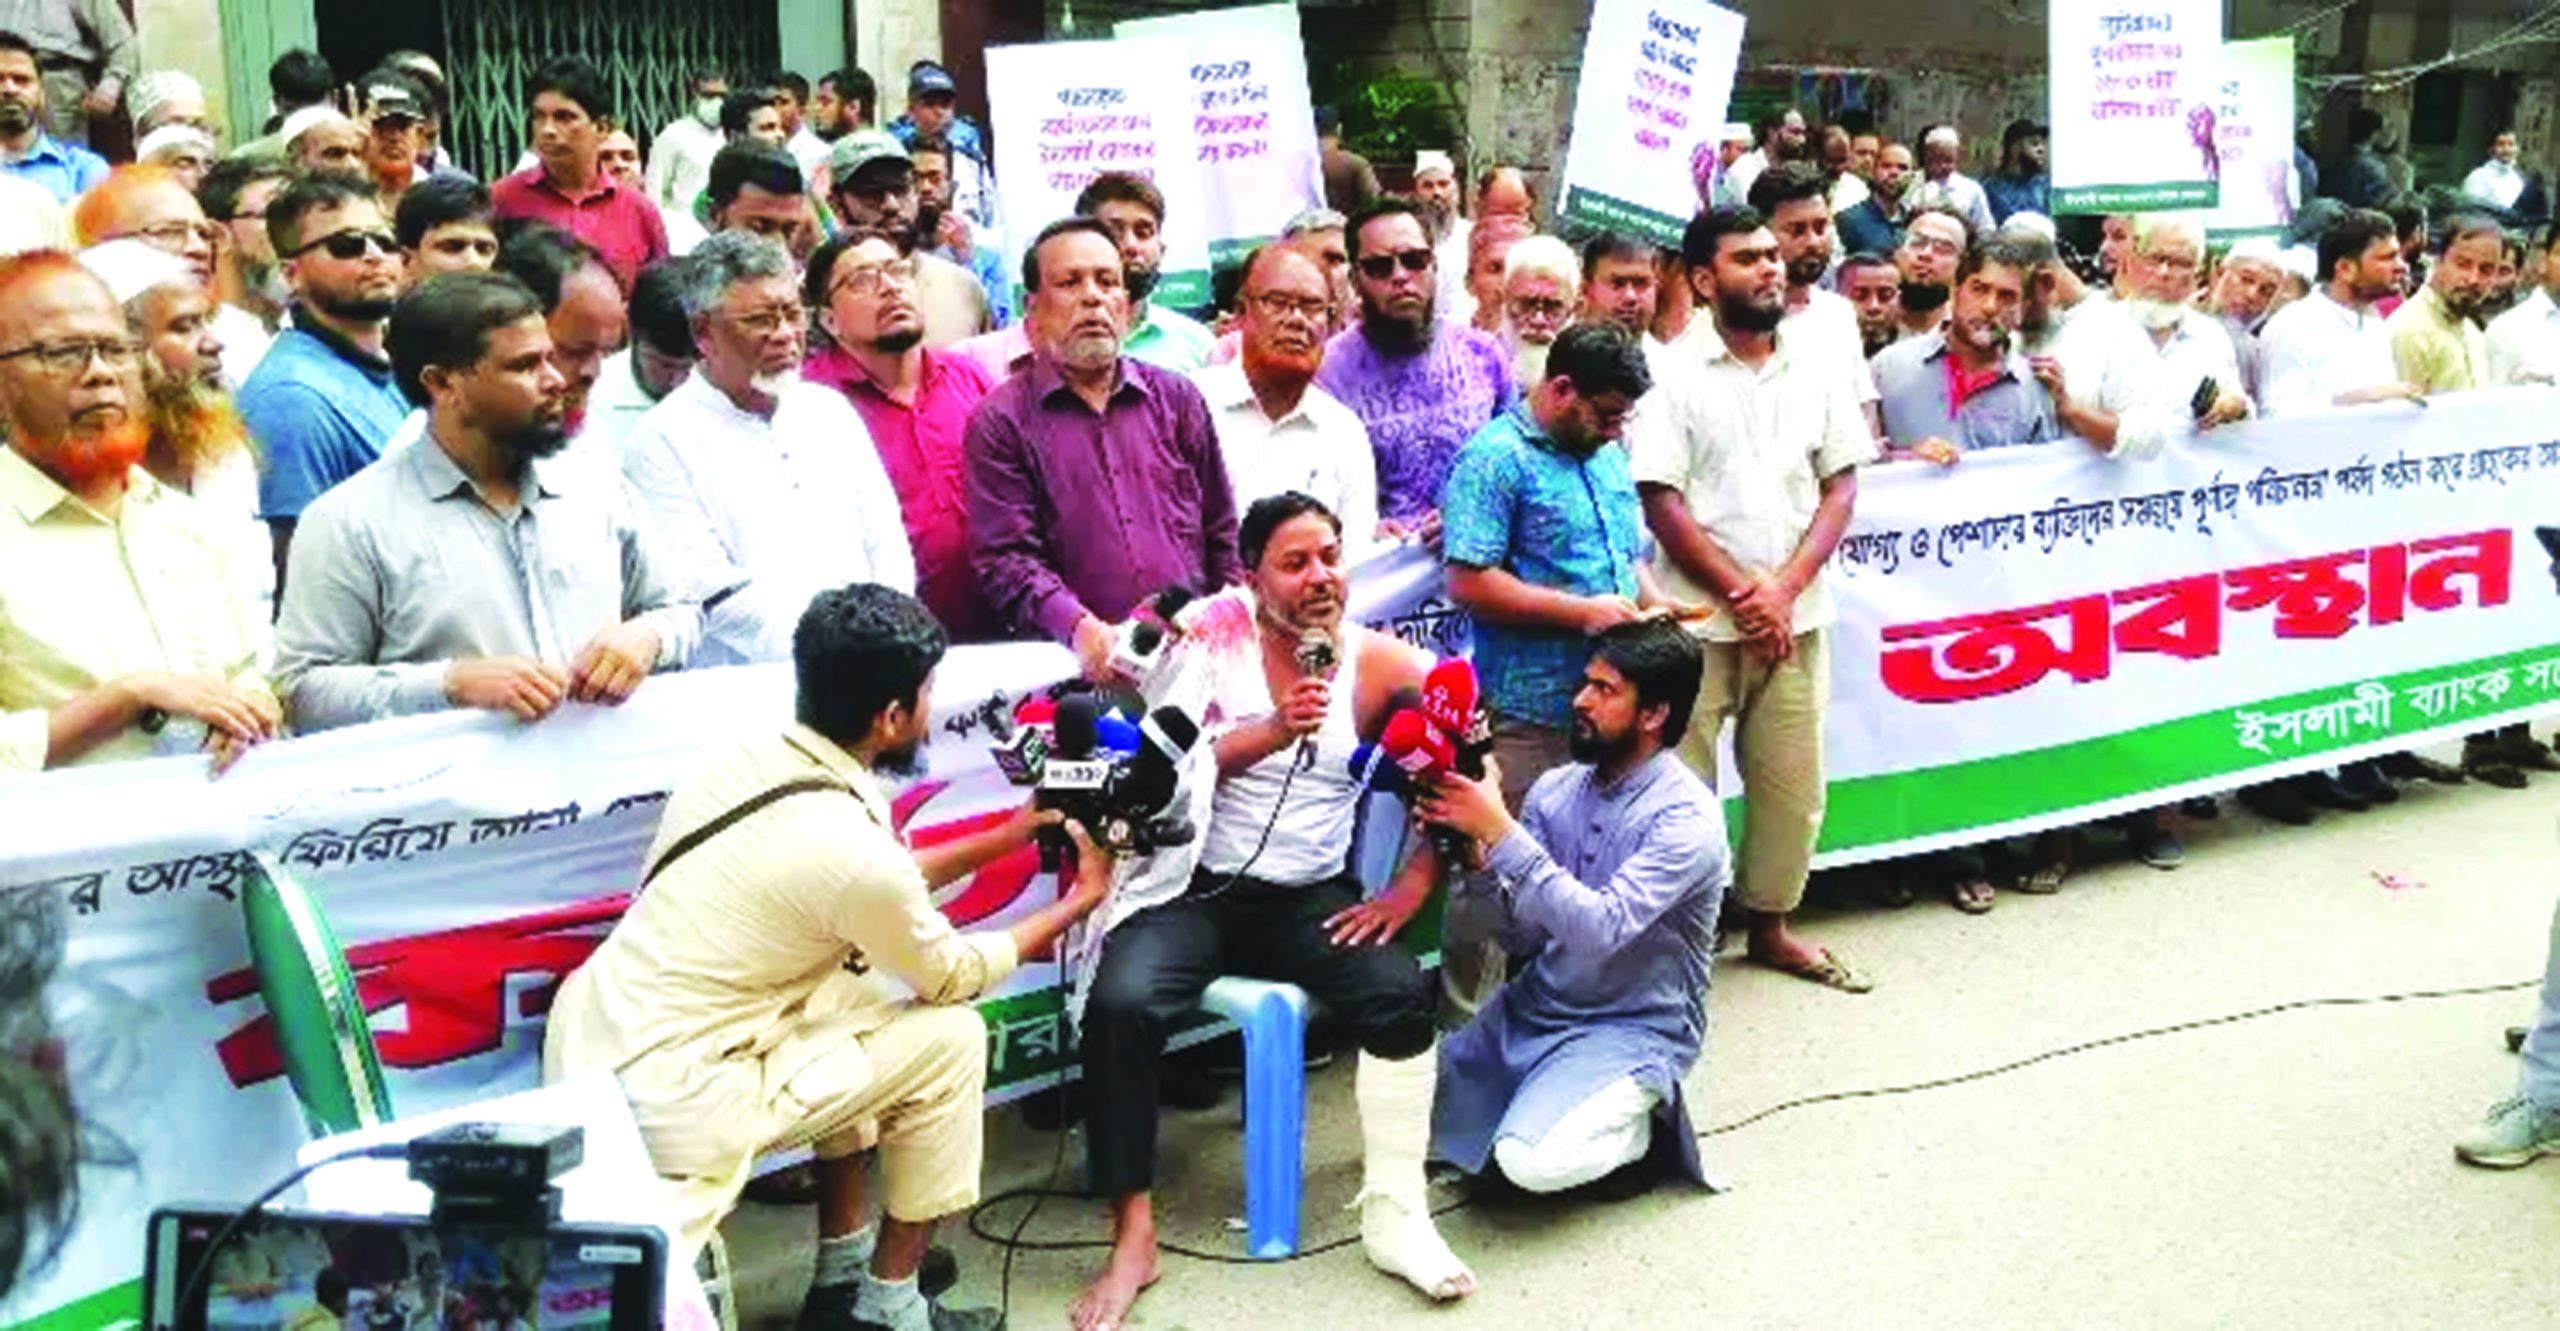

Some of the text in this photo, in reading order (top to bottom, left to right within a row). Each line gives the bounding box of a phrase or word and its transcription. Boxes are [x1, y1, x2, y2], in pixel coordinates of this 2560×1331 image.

[1838, 530, 1902, 577] যোগ্য
[1910, 527, 1929, 558] ও
[1880, 527, 2514, 706] অবস্থান
[2233, 680, 2395, 754] ইসলামী
[2405, 664, 2513, 717] ব্যাংক
